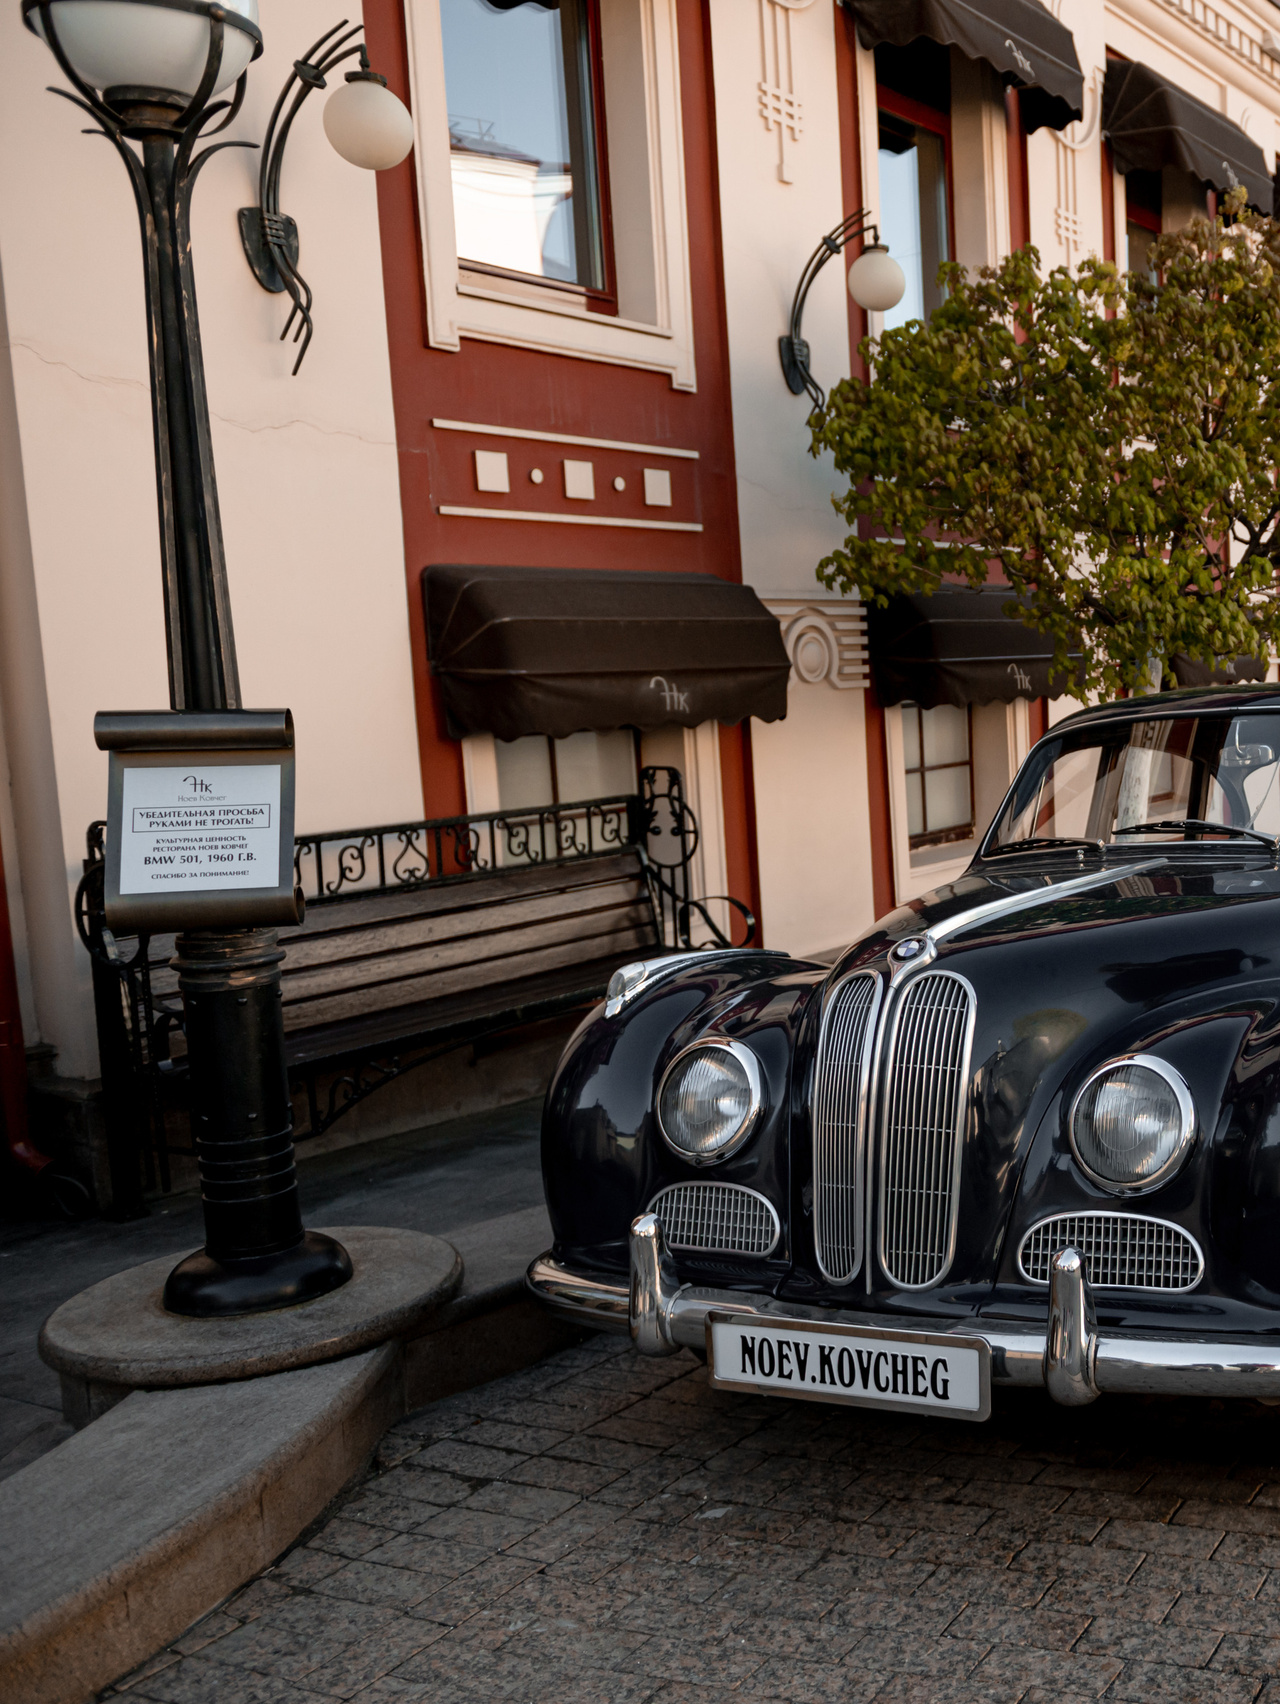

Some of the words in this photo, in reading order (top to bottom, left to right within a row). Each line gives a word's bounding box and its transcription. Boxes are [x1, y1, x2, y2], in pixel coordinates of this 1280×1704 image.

[199, 794, 227, 802] Ковчег
[139, 810, 215, 819] УБЕДИТЕЛЬНАЯ
[218, 807, 265, 817] ПРОСЬБА
[149, 819, 192, 828] РУКАМИ
[195, 818, 208, 827] НЕ
[211, 817, 254, 826] ТРОГАТЬ!
[205, 835, 247, 843] ЦЕННОСТЬ
[144, 855, 176, 865] BMW
[179, 854, 203, 865] 501,
[207, 853, 234, 863] 1960
[238, 852, 257, 861] Г.В.
[151, 872, 187, 880] СПАСИБО
[199, 870, 250, 878] ПОНИМАНИЕ!
[740, 1334, 950, 1400] NOEV.KOVCHEG
